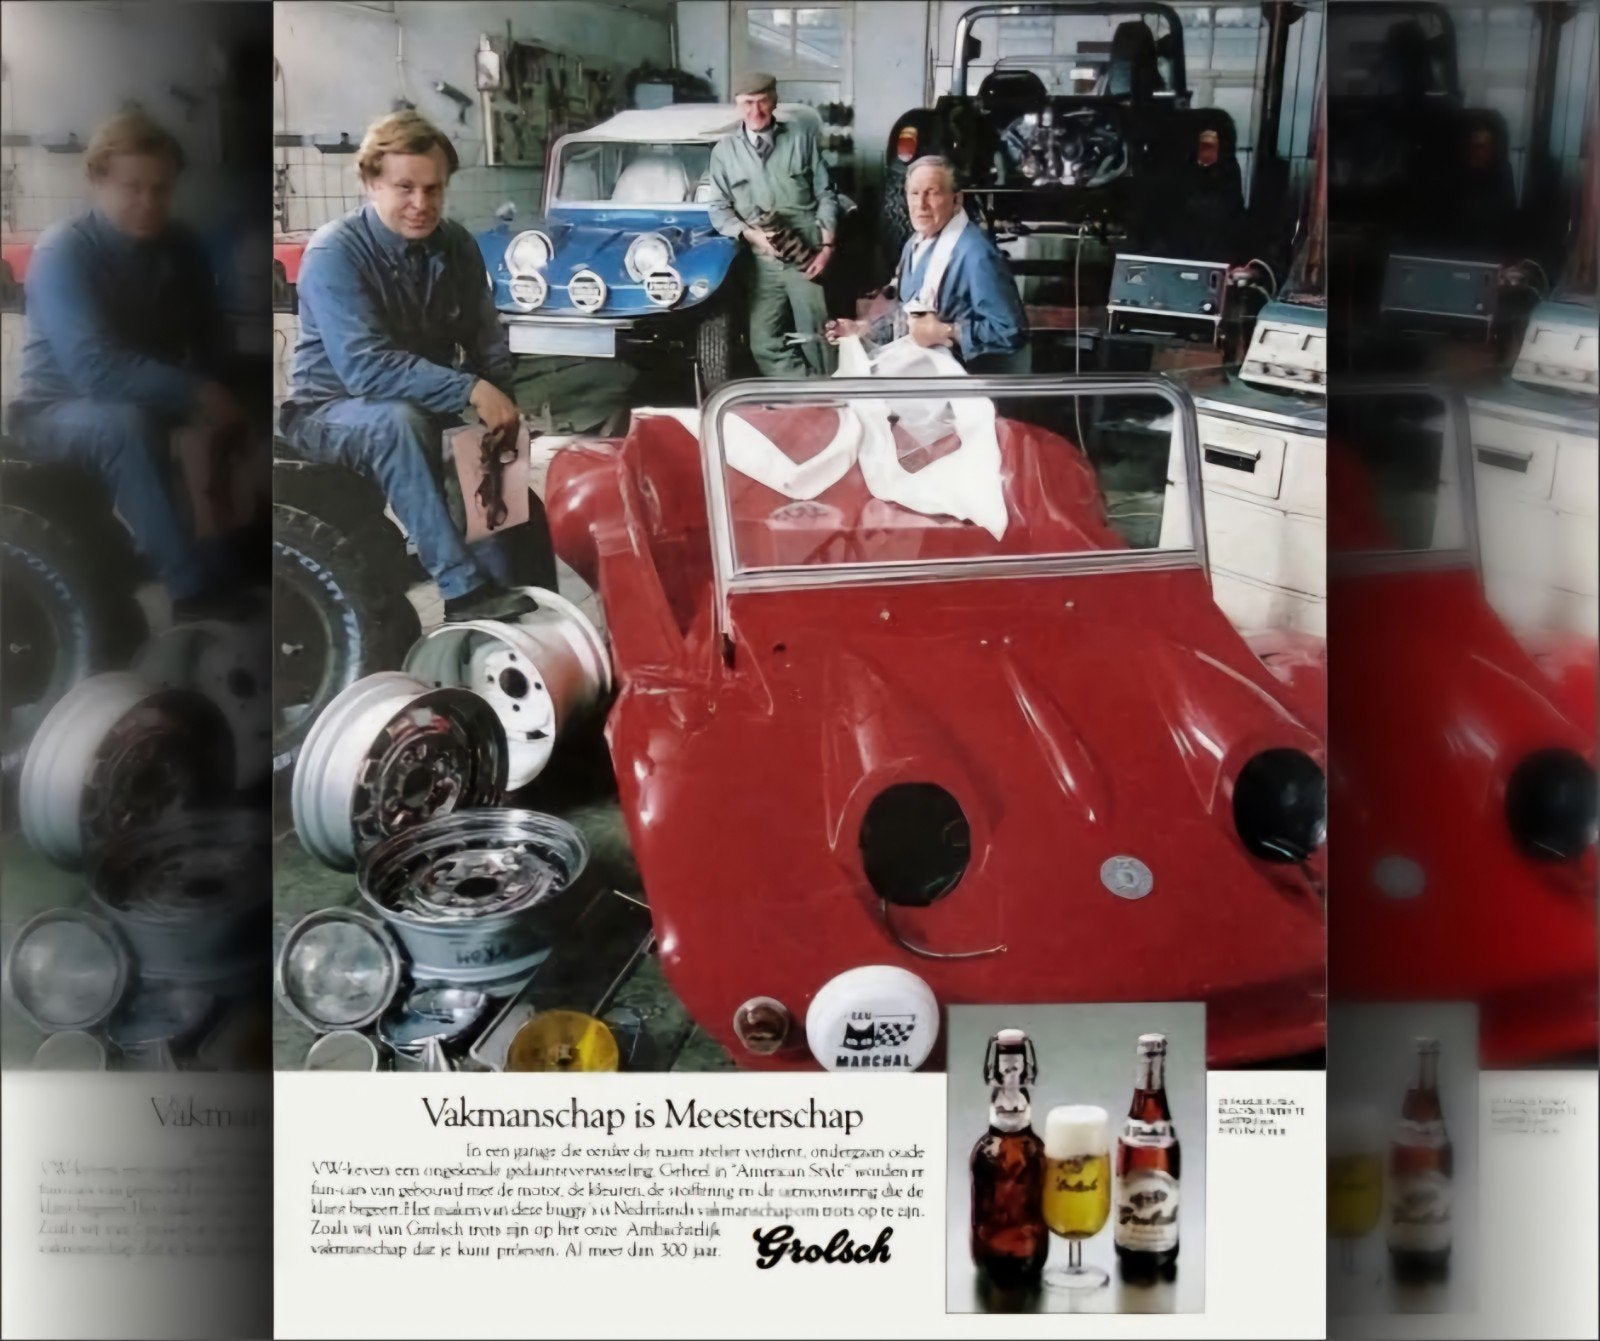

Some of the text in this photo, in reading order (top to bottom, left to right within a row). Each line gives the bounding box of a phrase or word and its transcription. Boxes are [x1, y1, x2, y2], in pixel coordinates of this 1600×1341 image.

[836, 1054, 912, 1067] MARCHAL
[421, 1096, 863, 1136] Vakmanschap is Meesterschap
[467, 1143, 481, 1157] In
[486, 1148, 509, 1157] een
[566, 1242, 581, 1257] Al
[661, 1243, 687, 1257] 300
[752, 1225, 894, 1269] Grolsch
